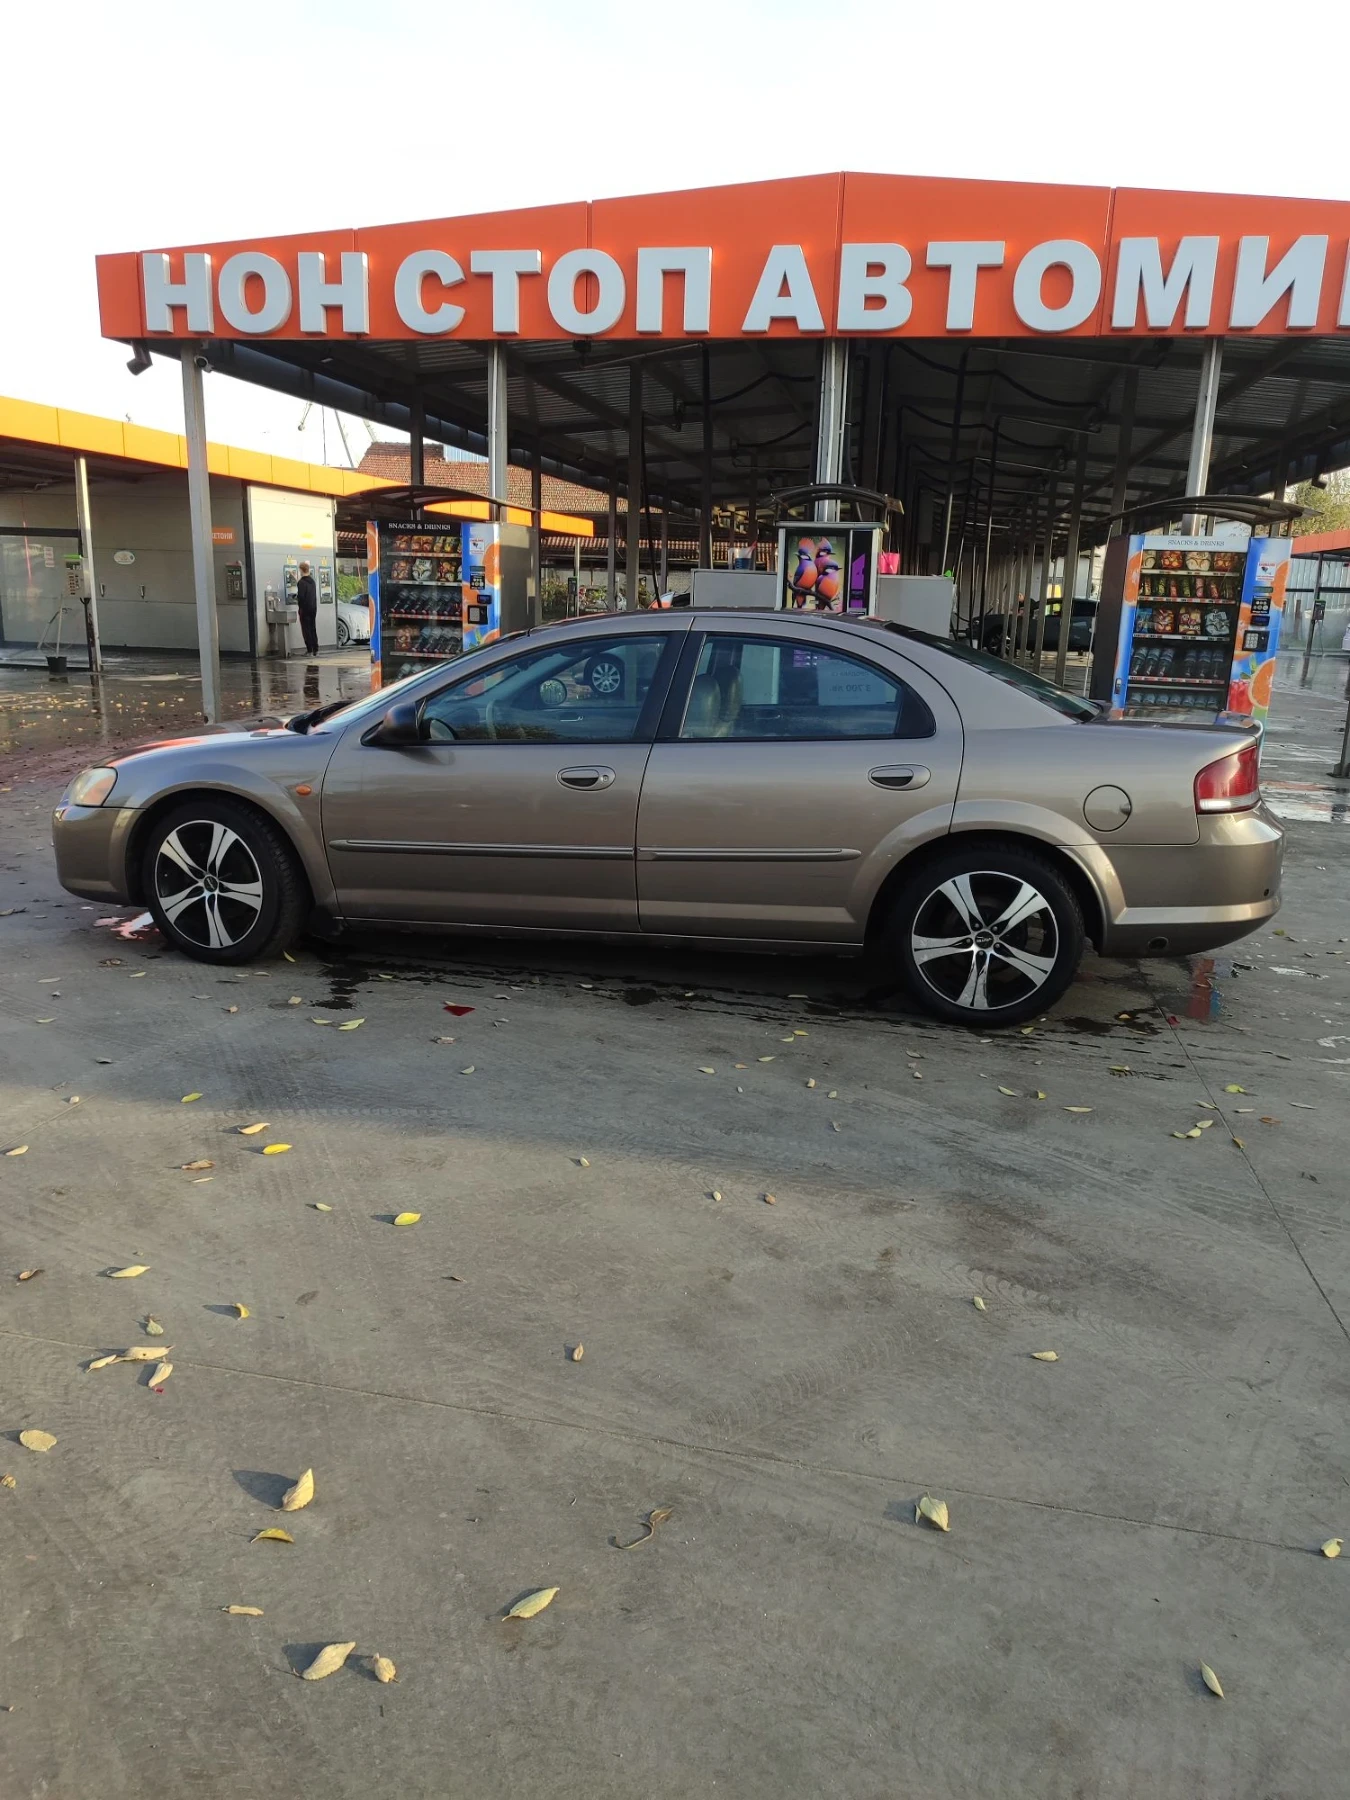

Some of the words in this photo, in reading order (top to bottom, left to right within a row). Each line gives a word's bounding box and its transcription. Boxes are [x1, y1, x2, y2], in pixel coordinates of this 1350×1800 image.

[142, 251, 370, 334] НОН
[394, 246, 713, 335] СТОП
[741, 234, 1350, 333] АВТОМИ
